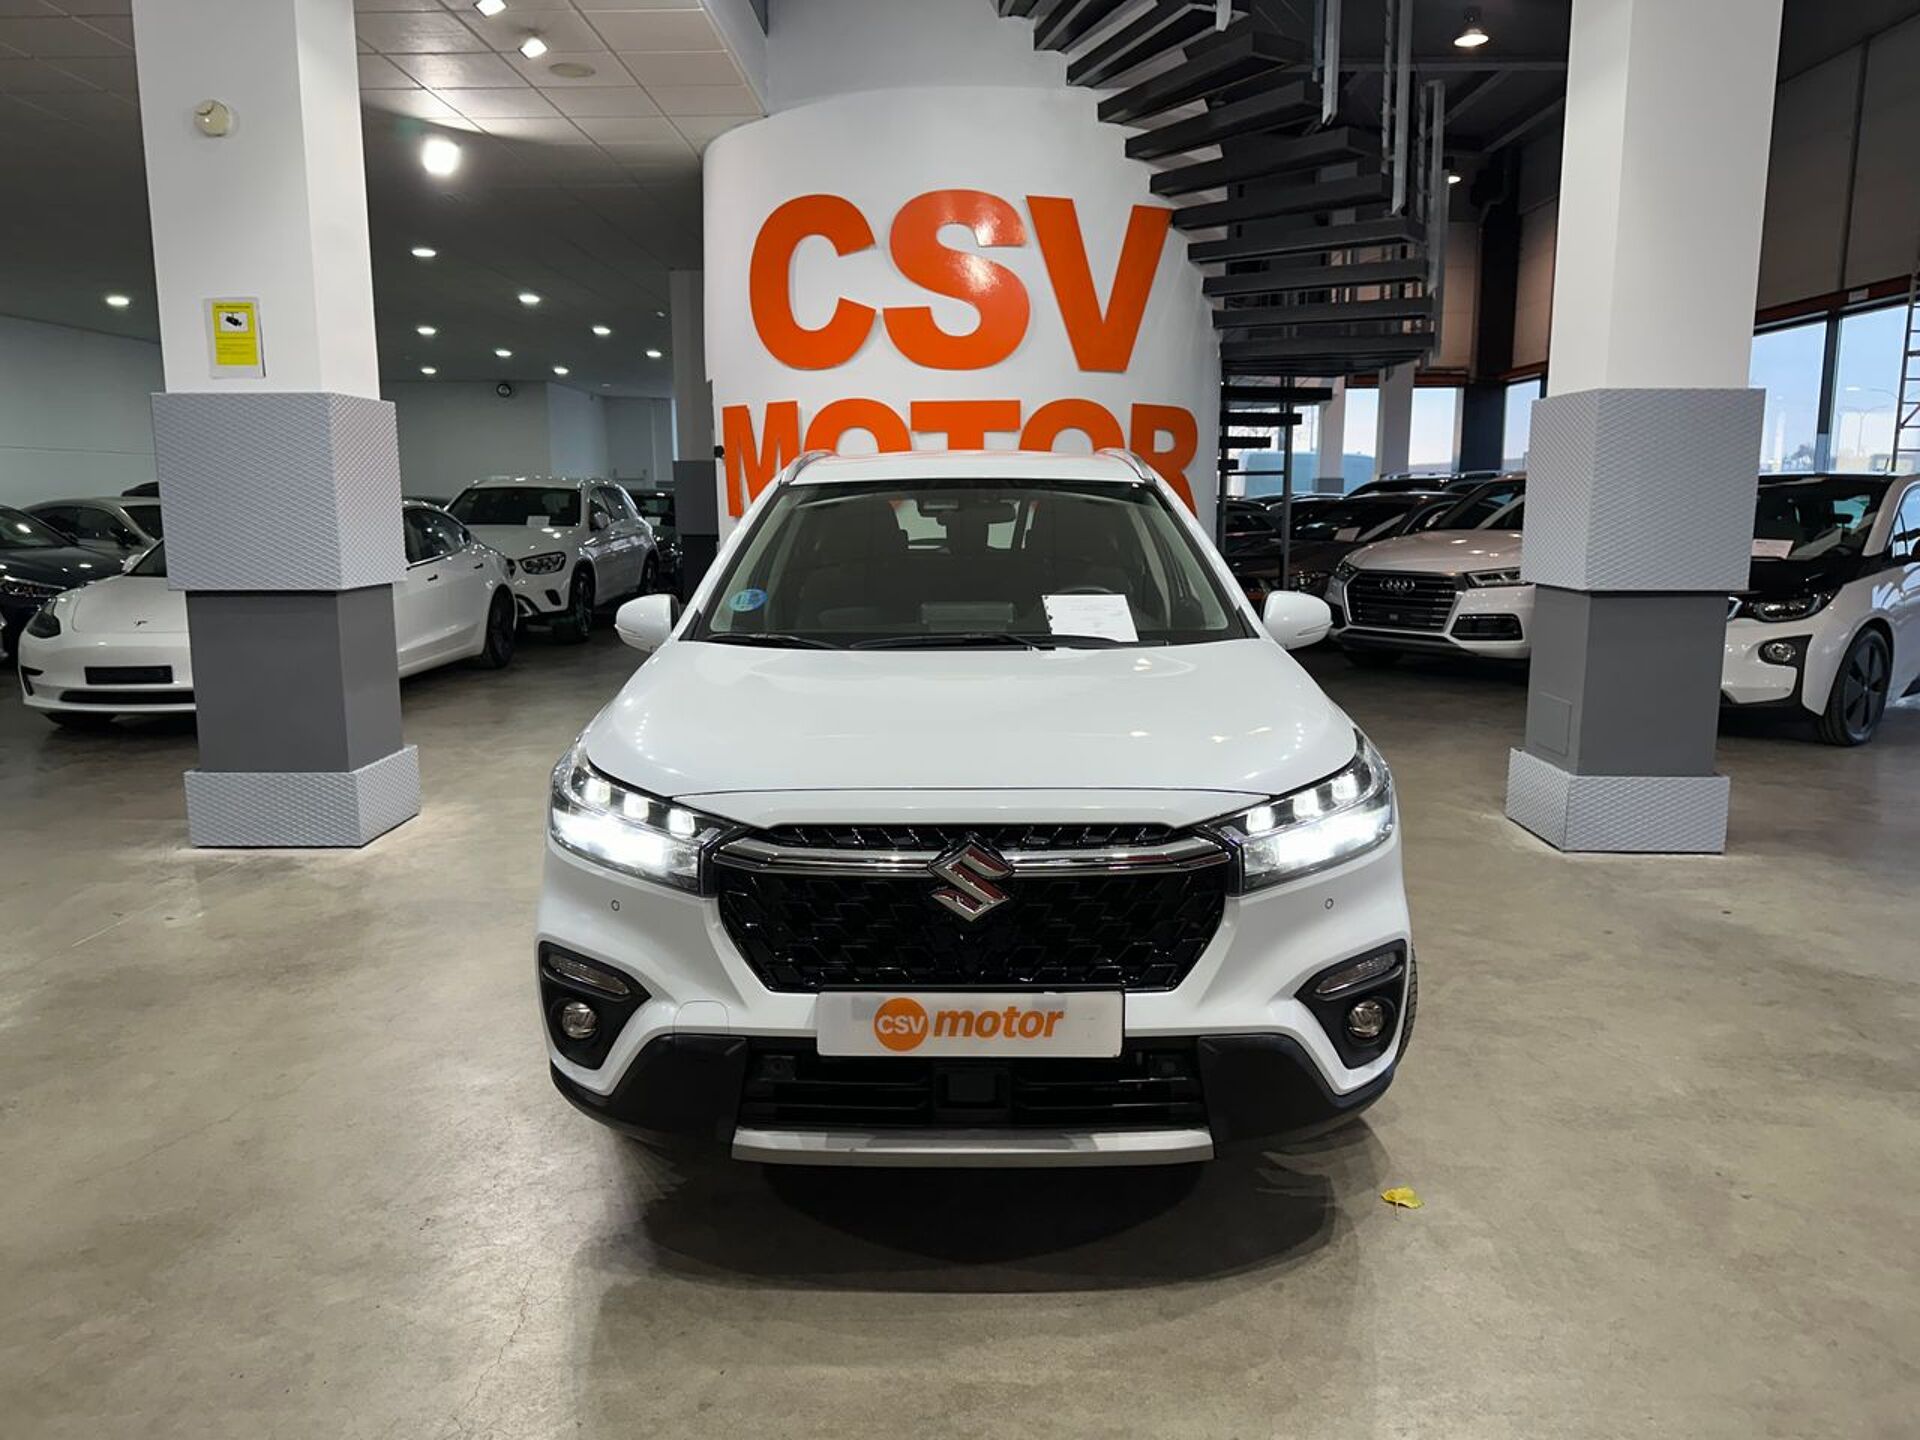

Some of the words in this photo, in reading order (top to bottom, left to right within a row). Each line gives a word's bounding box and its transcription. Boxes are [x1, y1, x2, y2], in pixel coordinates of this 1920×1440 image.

[749, 189, 1172, 373] CSV
[876, 1014, 926, 1035] CSV
[933, 1006, 1065, 1039] motor
